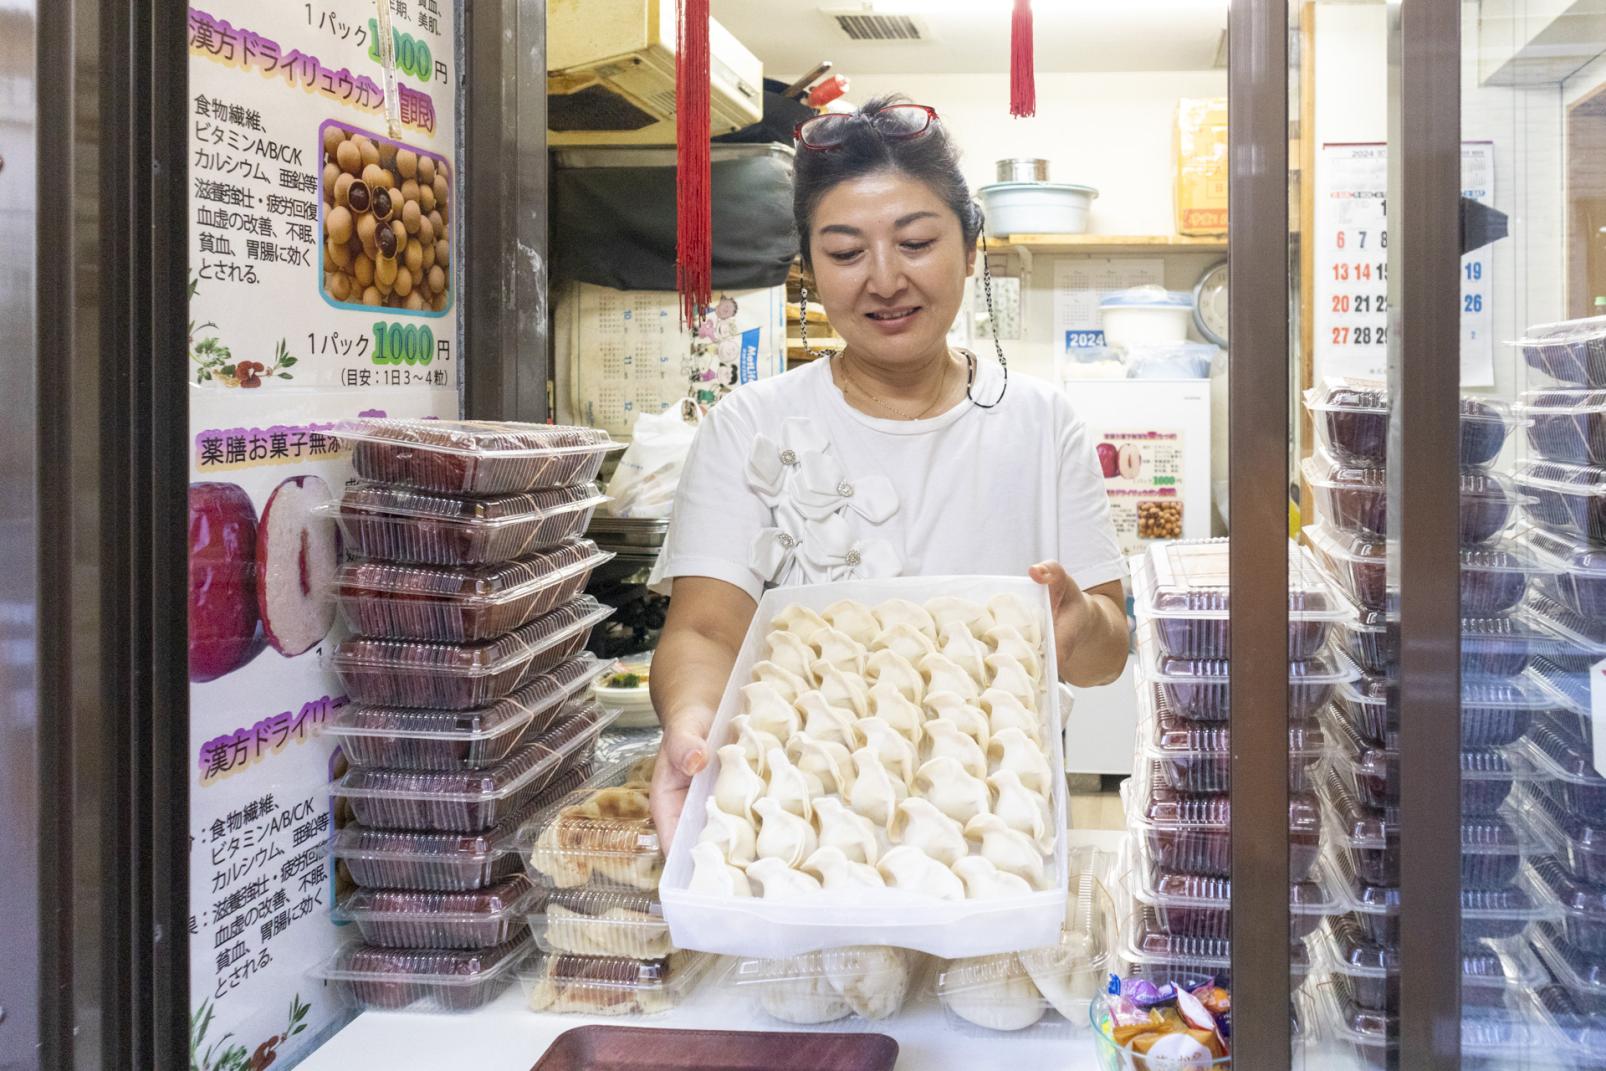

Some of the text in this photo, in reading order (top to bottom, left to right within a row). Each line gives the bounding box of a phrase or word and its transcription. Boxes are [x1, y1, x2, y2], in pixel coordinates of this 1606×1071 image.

[1337, 230, 1387, 249] 6 7 8
[1332, 263, 1349, 280] 13
[1354, 263, 1371, 280] 14
[1464, 262, 1482, 280] 19
[1332, 295, 1349, 312] 20
[1354, 295, 1370, 312] 21
[1464, 294, 1482, 312] 26
[1070, 333, 1105, 346] 2024
[1332, 327, 1349, 344] 27
[1354, 327, 1371, 344] 28
